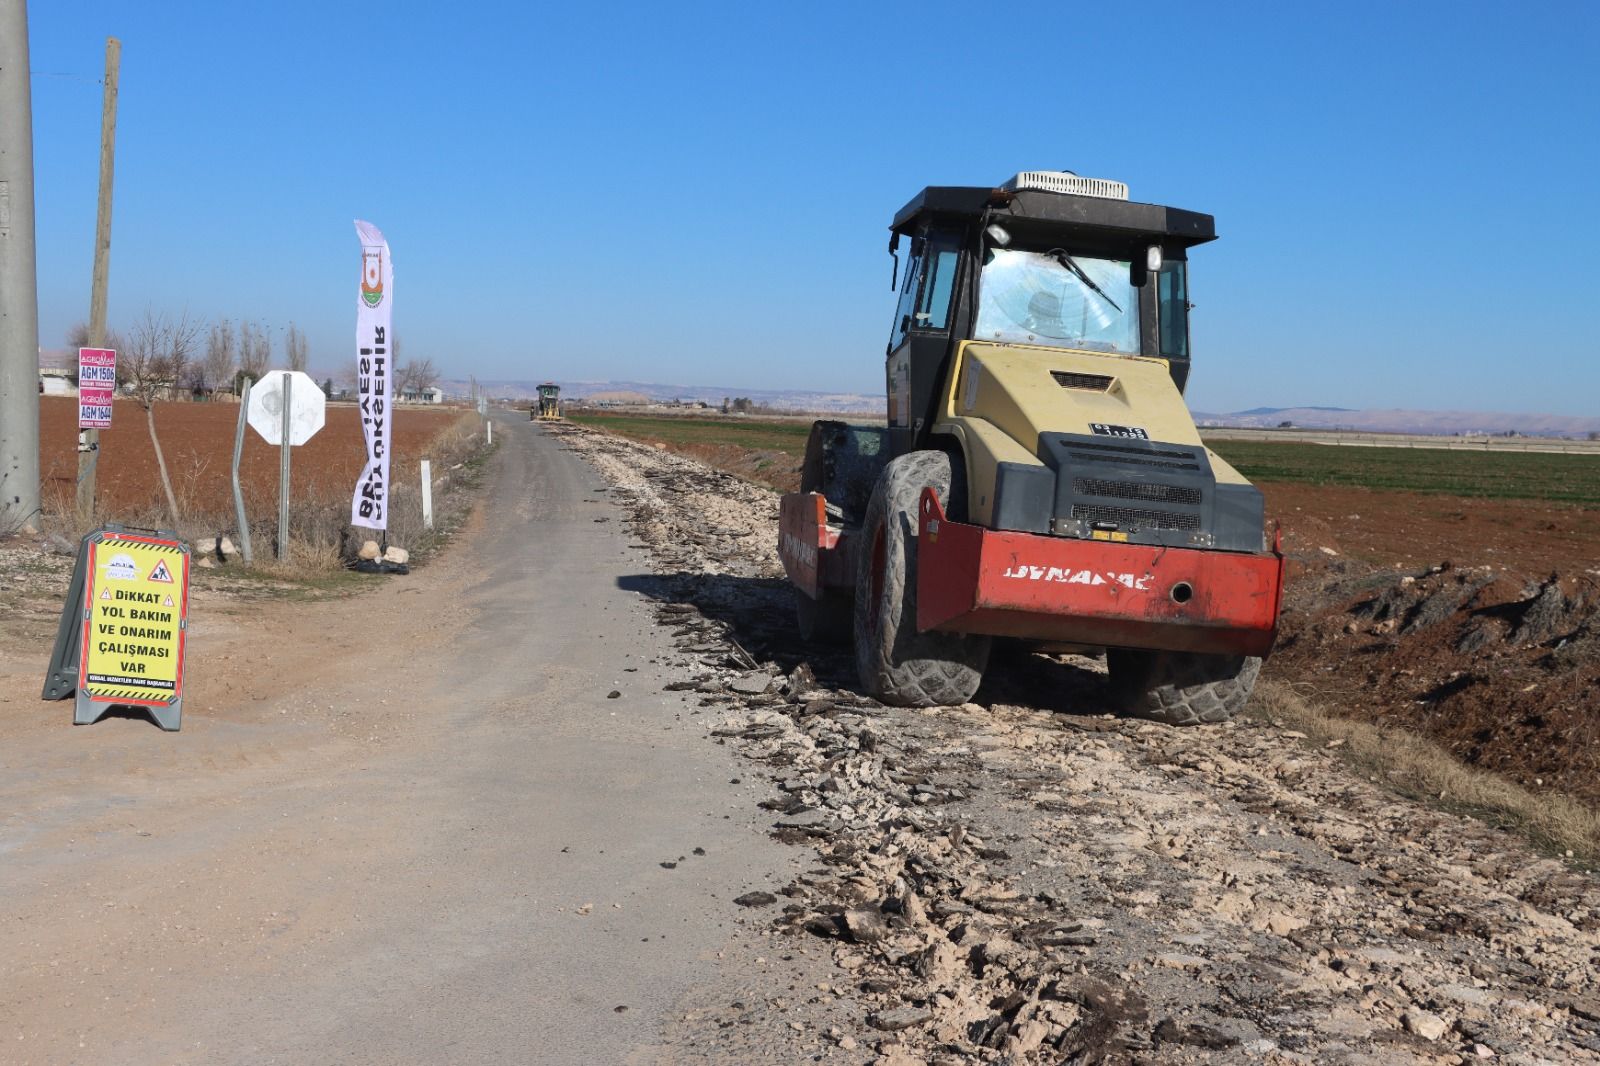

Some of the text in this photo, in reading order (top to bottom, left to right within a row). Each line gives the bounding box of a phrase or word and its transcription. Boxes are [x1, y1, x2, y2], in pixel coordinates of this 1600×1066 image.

[81, 366, 114, 380] AGM 1506
[81, 406, 97, 419] AGM
[101, 606, 171, 623] YOL BAKIM
[99, 623, 171, 640] VE ONARIM
[98, 642, 169, 658] ÇALIŞMASI
[120, 661, 146, 673] VAR
